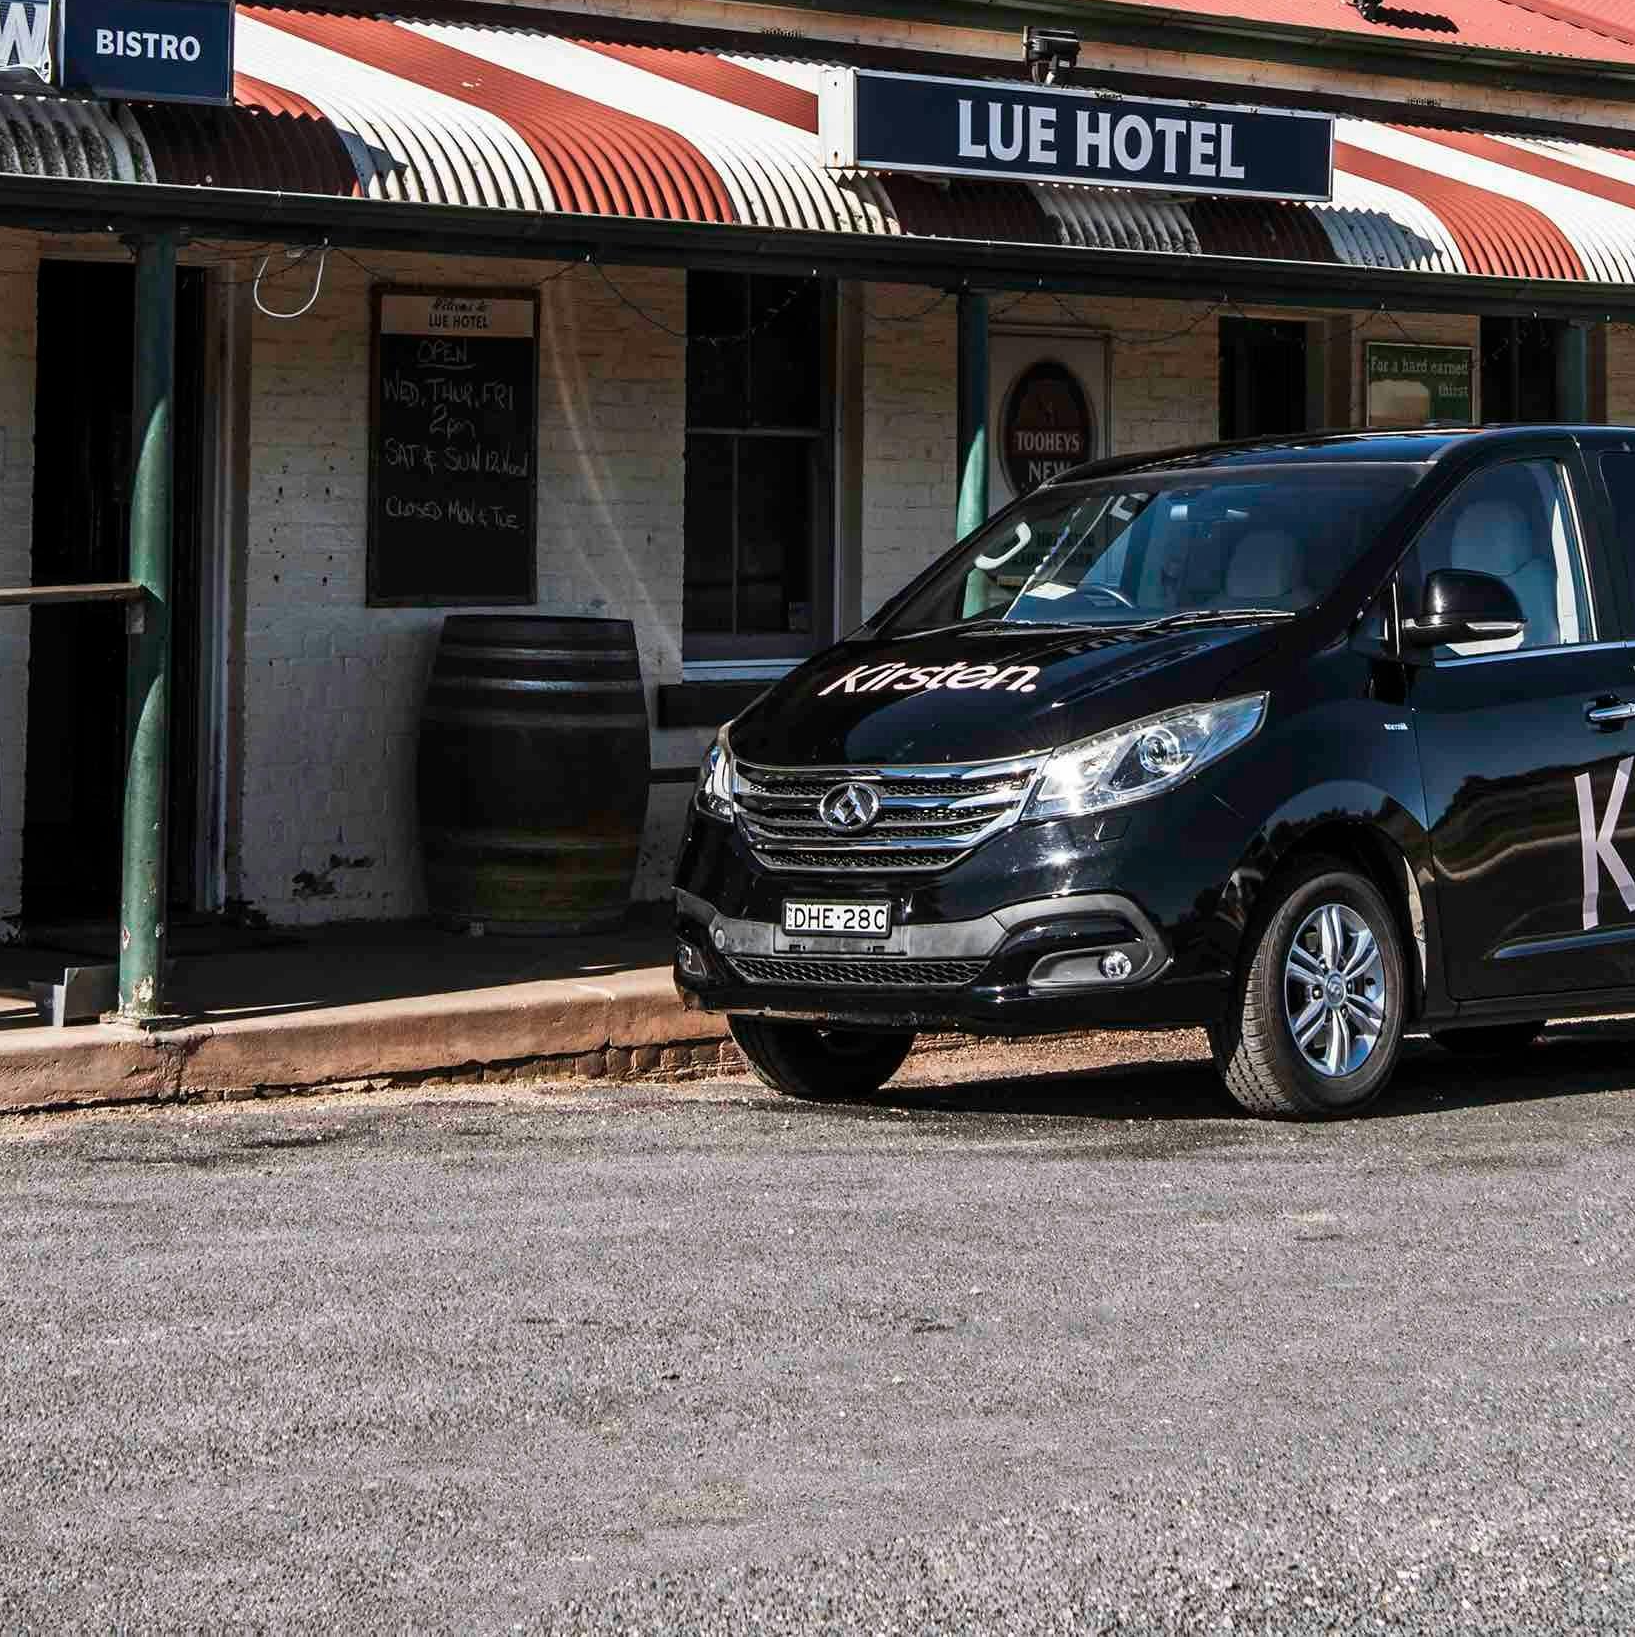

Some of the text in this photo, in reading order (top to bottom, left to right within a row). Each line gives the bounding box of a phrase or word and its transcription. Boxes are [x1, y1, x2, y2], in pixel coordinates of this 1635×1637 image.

[95, 26, 202, 62] BISTRO
[958, 98, 1246, 180] LUE HOTEL
[428, 313, 489, 330] LUE HOTEL
[415, 338, 468, 363] OPEN
[384, 436, 421, 473] SAT
[443, 440, 482, 474] SUN
[1016, 432, 1081, 453] TOOHEYS
[384, 494, 443, 522] CLOSED
[448, 496, 477, 529] MON
[818, 662, 1040, 697] Kirsten.
